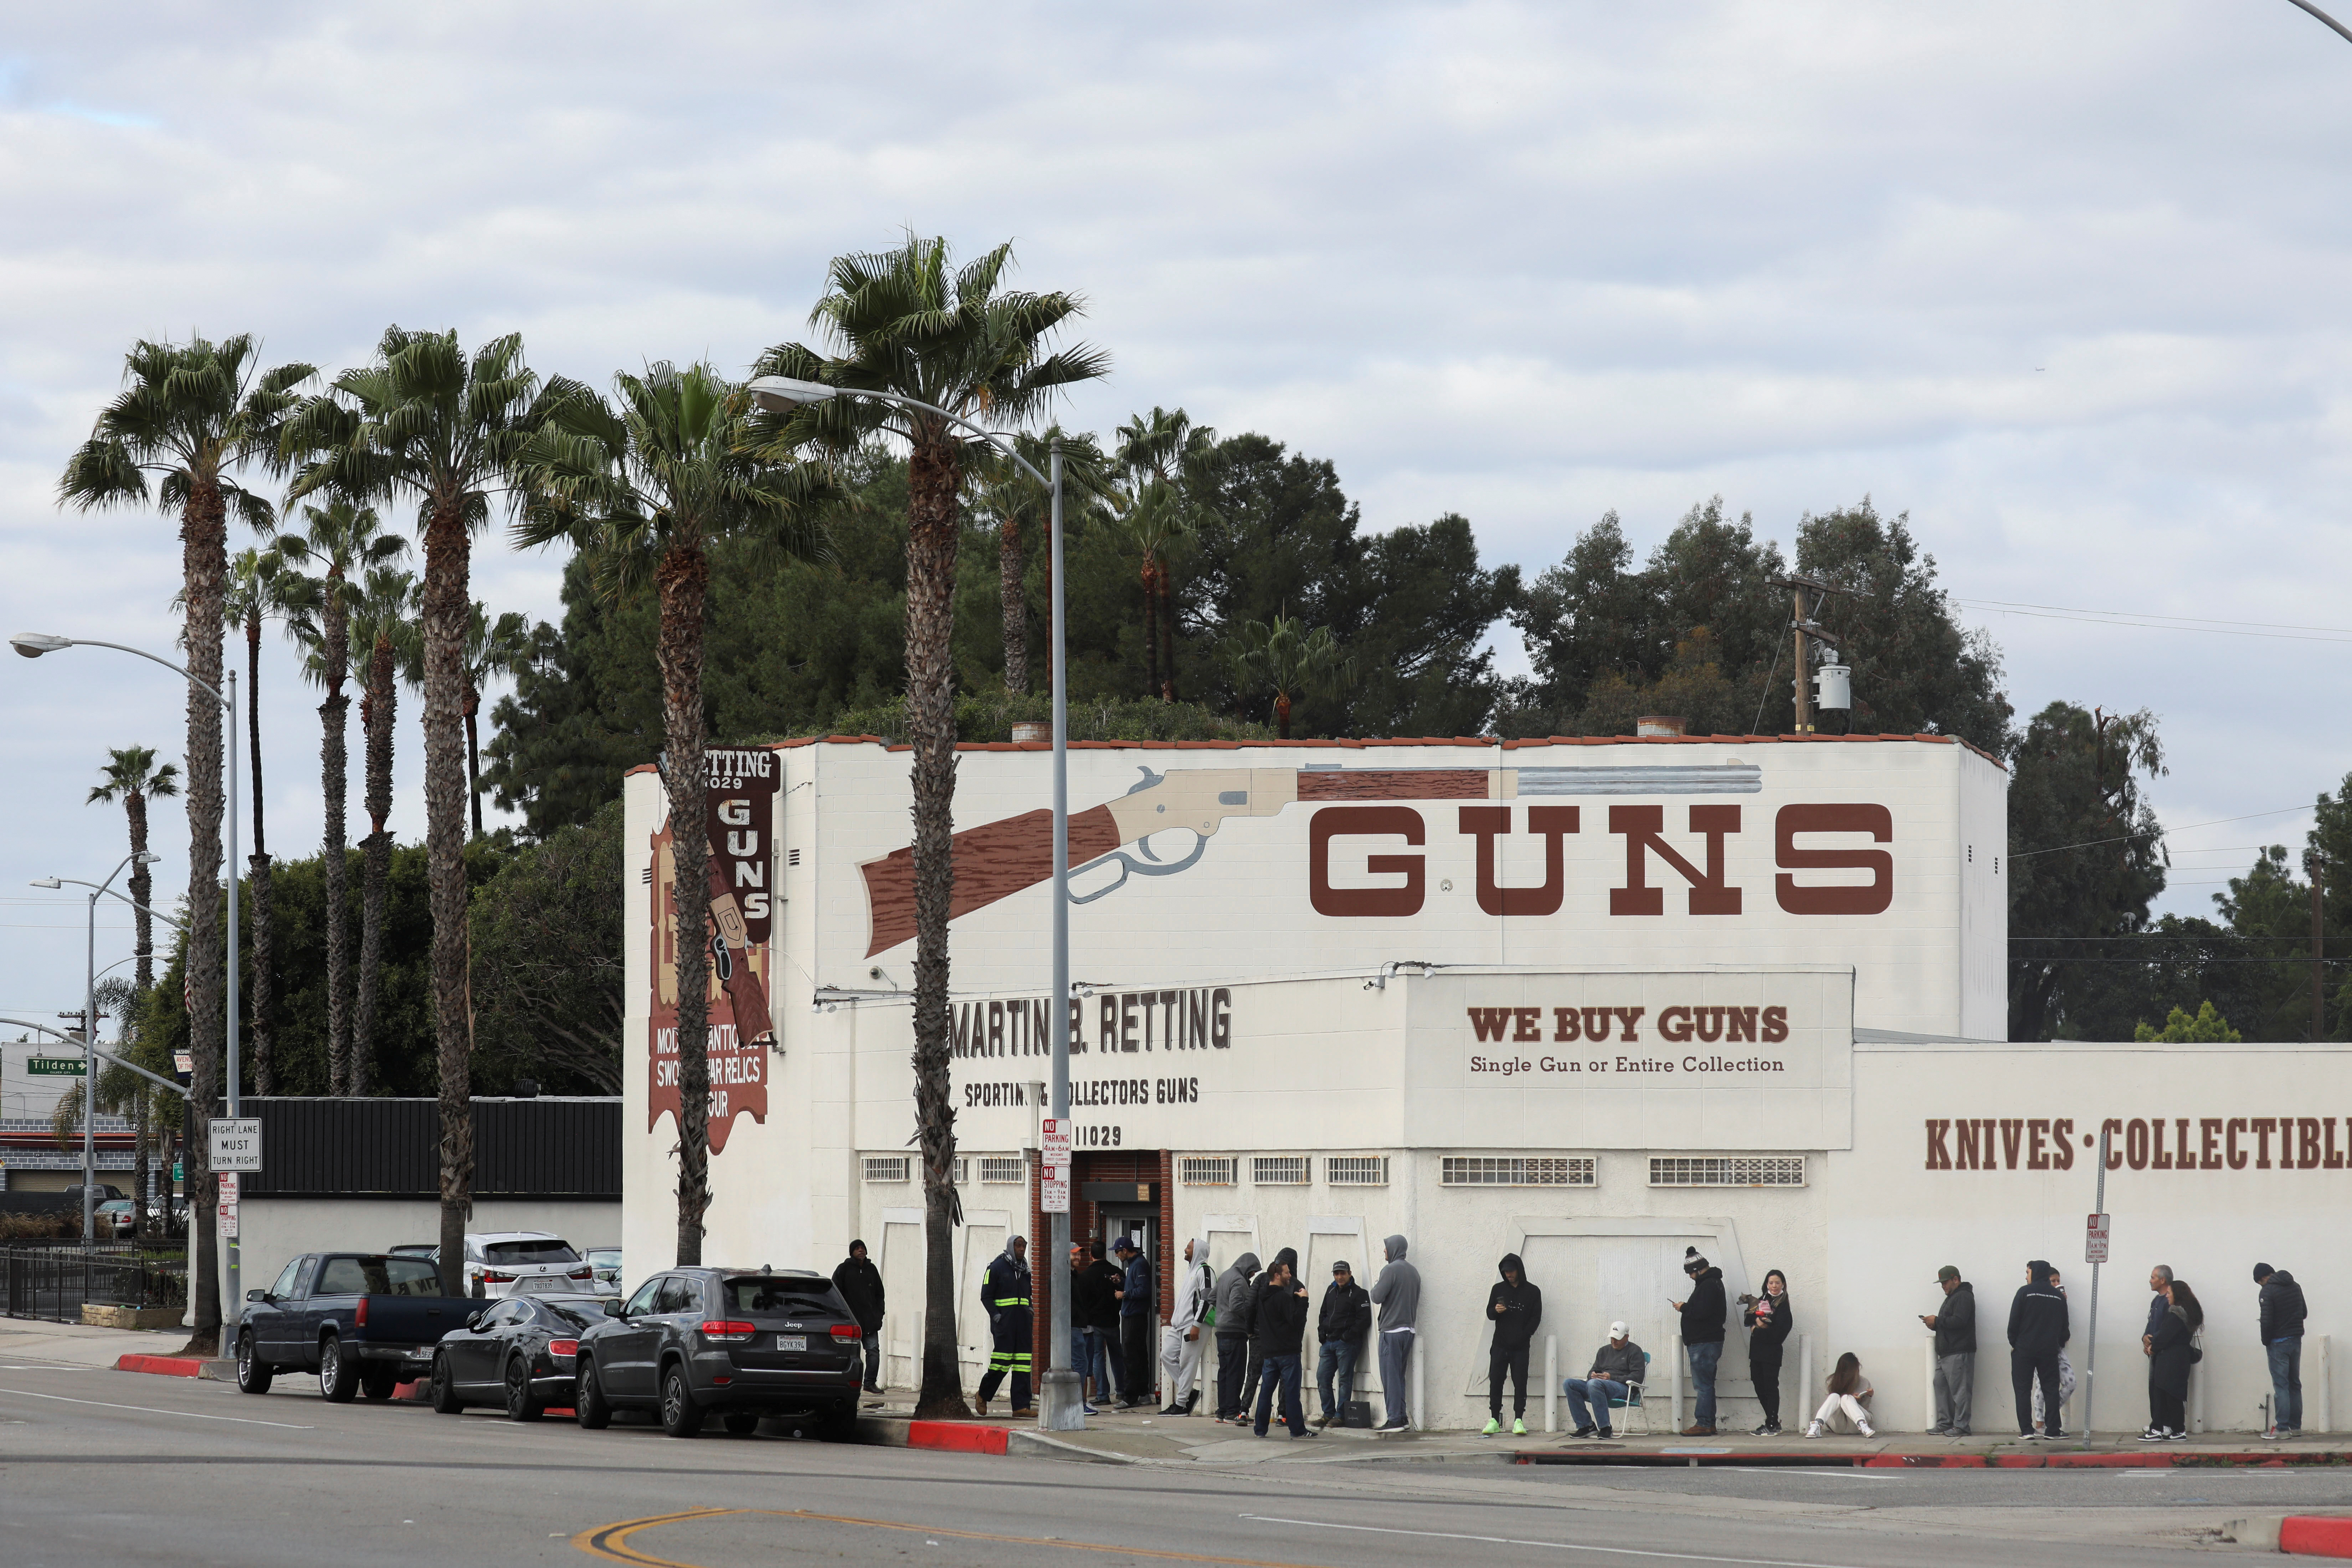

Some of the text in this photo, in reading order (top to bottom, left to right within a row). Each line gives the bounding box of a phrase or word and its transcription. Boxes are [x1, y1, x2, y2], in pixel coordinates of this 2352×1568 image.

[702, 750, 771, 778] ETTING
[705, 777, 742, 789] 029
[718, 800, 769, 919] GUNS
[1310, 804, 1893, 916] GUNS
[949, 998, 1051, 1058] MARTIN
[1100, 988, 1231, 1053] RETTING
[1467, 1006, 1789, 1043] WE BUY GUNS
[657, 1024, 759, 1055] MOD ANTIQ
[33, 1060, 74, 1070] Tilden
[657, 1060, 681, 1087] SWO
[725, 1056, 760, 1084] RELICS
[1471, 1056, 1784, 1076] Single Gun or Entire Collection
[965, 1077, 1198, 1107] SPORTIN & OLLECTORS GUNS
[1045, 1121, 1054, 1131] NO
[1075, 1126, 1121, 1146] 11029
[221, 1140, 248, 1150] MUST
[1045, 1134, 1069, 1143] PARKING
[1925, 1117, 2352, 1171] KNIVES COLLECTIBL
[1044, 1168, 1053, 1178] NO
[1044, 1180, 1067, 1188] STOPPING
[2089, 1217, 2096, 1227] NO
[2089, 1230, 2107, 1239] PARKING
